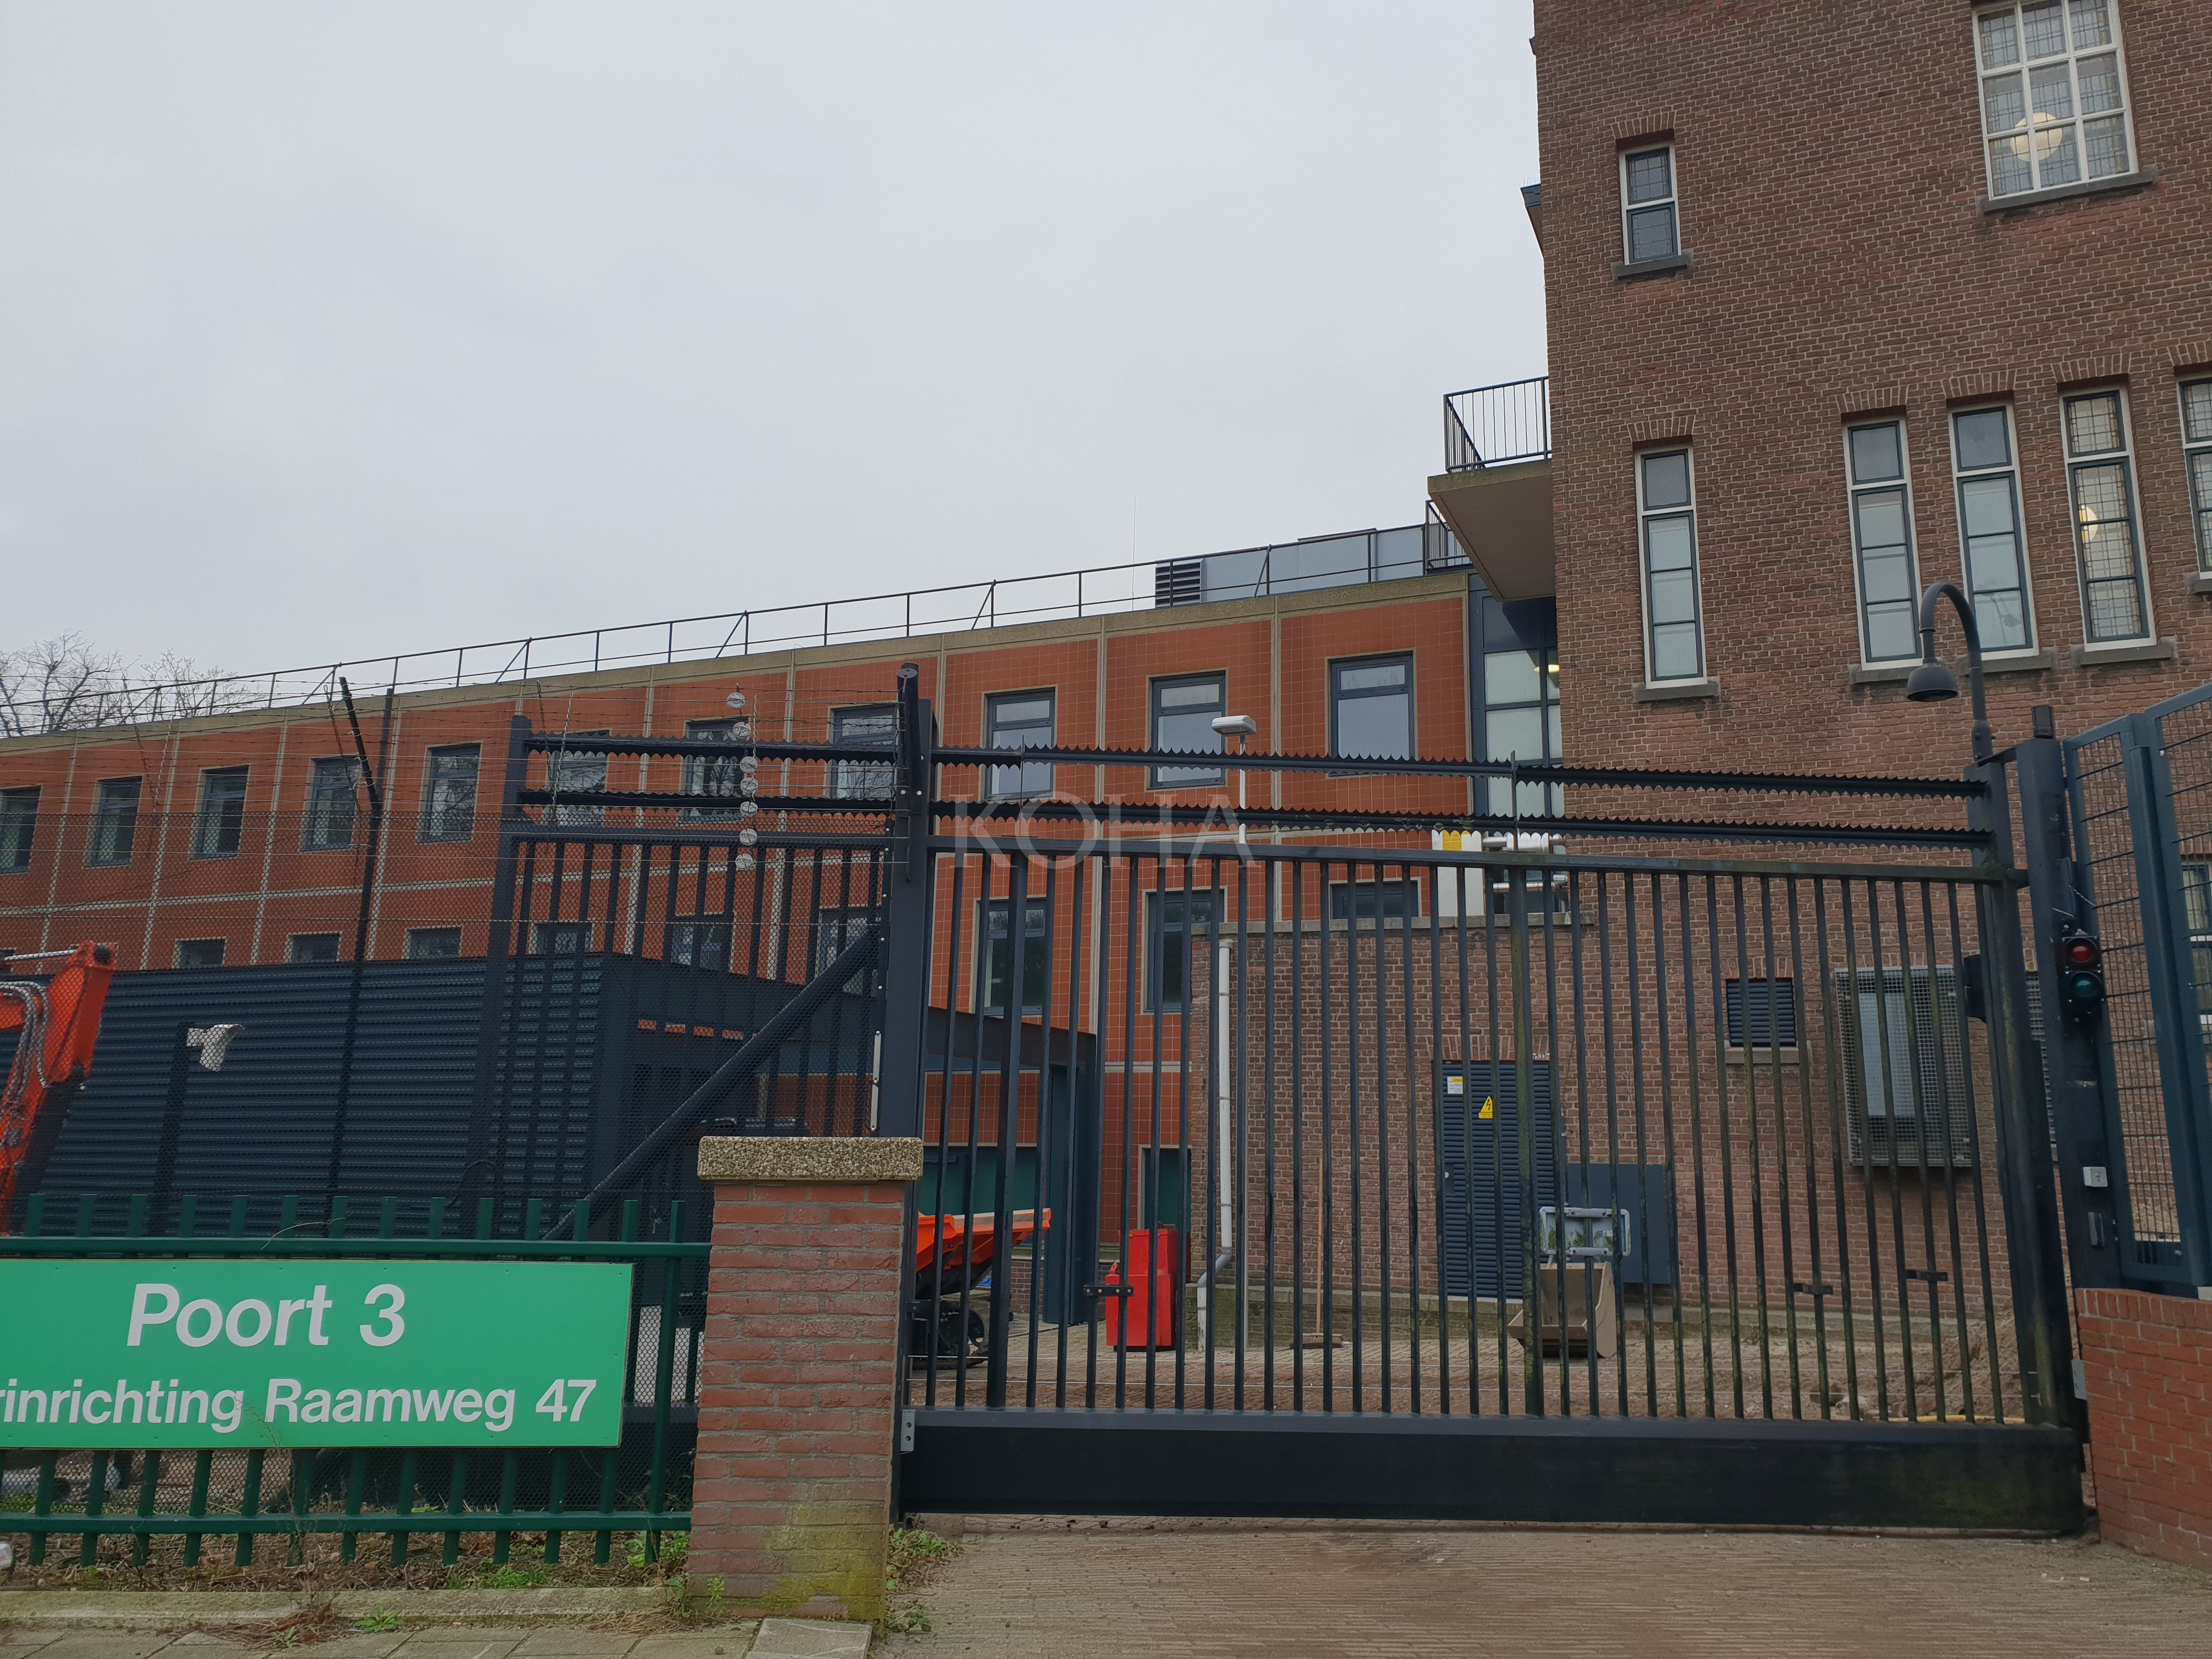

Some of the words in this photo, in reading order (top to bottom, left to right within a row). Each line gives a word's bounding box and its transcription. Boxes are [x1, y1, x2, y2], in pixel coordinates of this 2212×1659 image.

[127, 1284, 332, 1347] Poort
[360, 1284, 405, 1347] 3
[265, 1379, 515, 1432] Raamweg
[536, 1379, 596, 1423] 47
